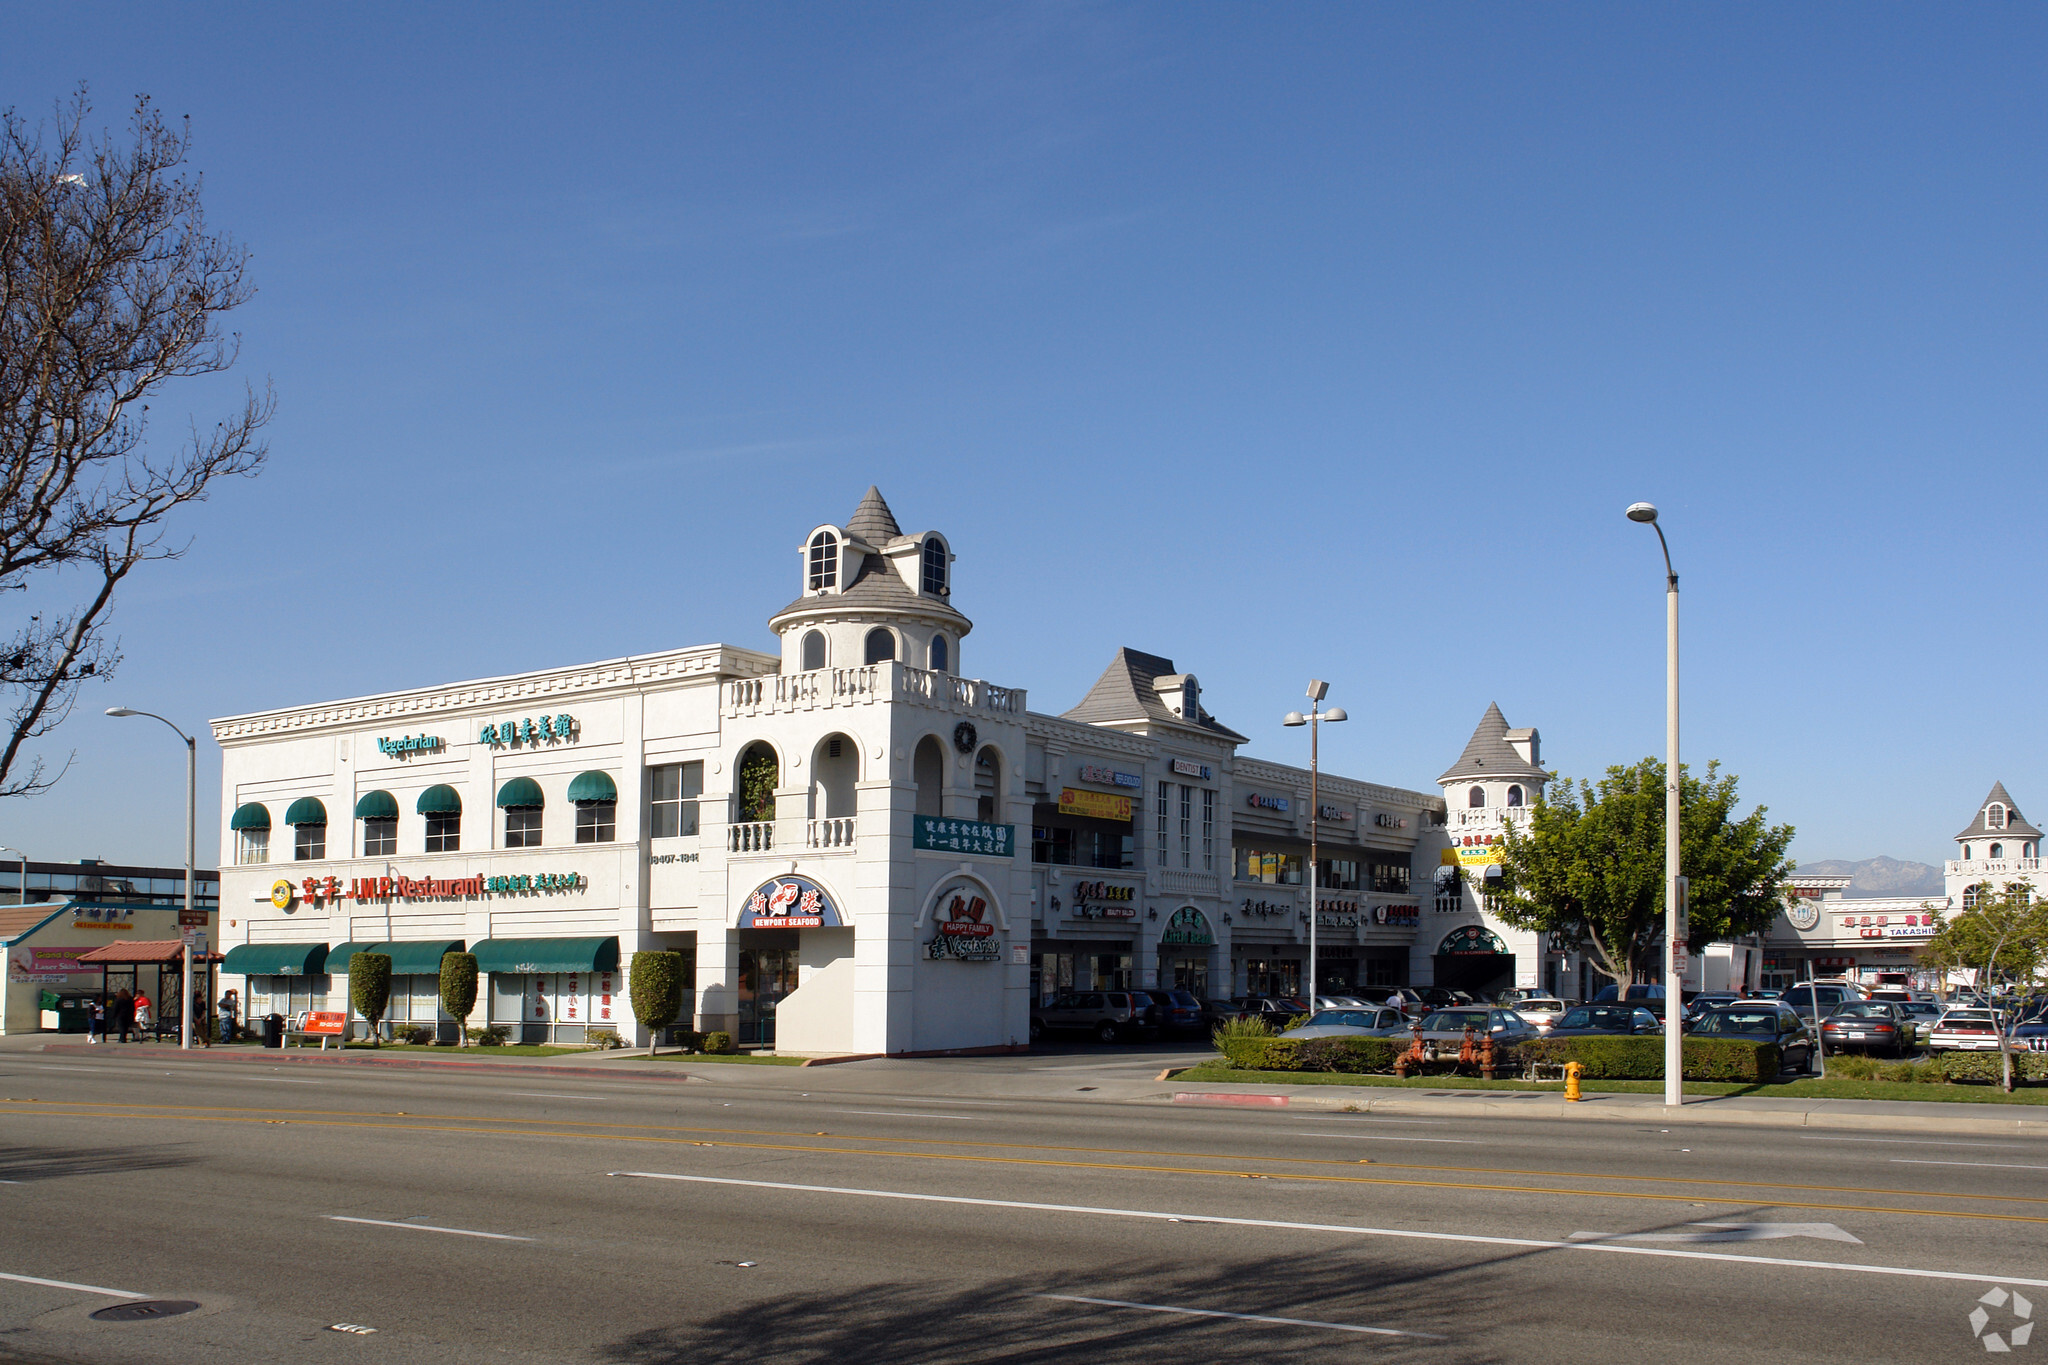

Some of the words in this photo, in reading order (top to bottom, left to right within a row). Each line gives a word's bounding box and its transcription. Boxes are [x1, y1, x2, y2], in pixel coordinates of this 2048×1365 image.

[480, 714, 573, 745] 欣園素菜館
[377, 733, 437, 755] Vegetarian
[1176, 761, 1199, 774] DENTIST
[925, 821, 1006, 842] 健康素食在欣園
[926, 835, 1005, 853] 十一週年大送禮
[398, 873, 483, 897] Restaurant
[749, 891, 767, 915] 新
[800, 889, 821, 913] 港
[755, 918, 786, 927] NEWPORT
[788, 918, 819, 926] SEAFOOD
[946, 923, 967, 931] HAPPY
[968, 924, 990, 932] FAMILY
[1164, 929, 1189, 943] Little
[1190, 930, 1211, 944] Bean
[35, 951, 62, 959] Grand
[948, 936, 1000, 957] Vegetarian
